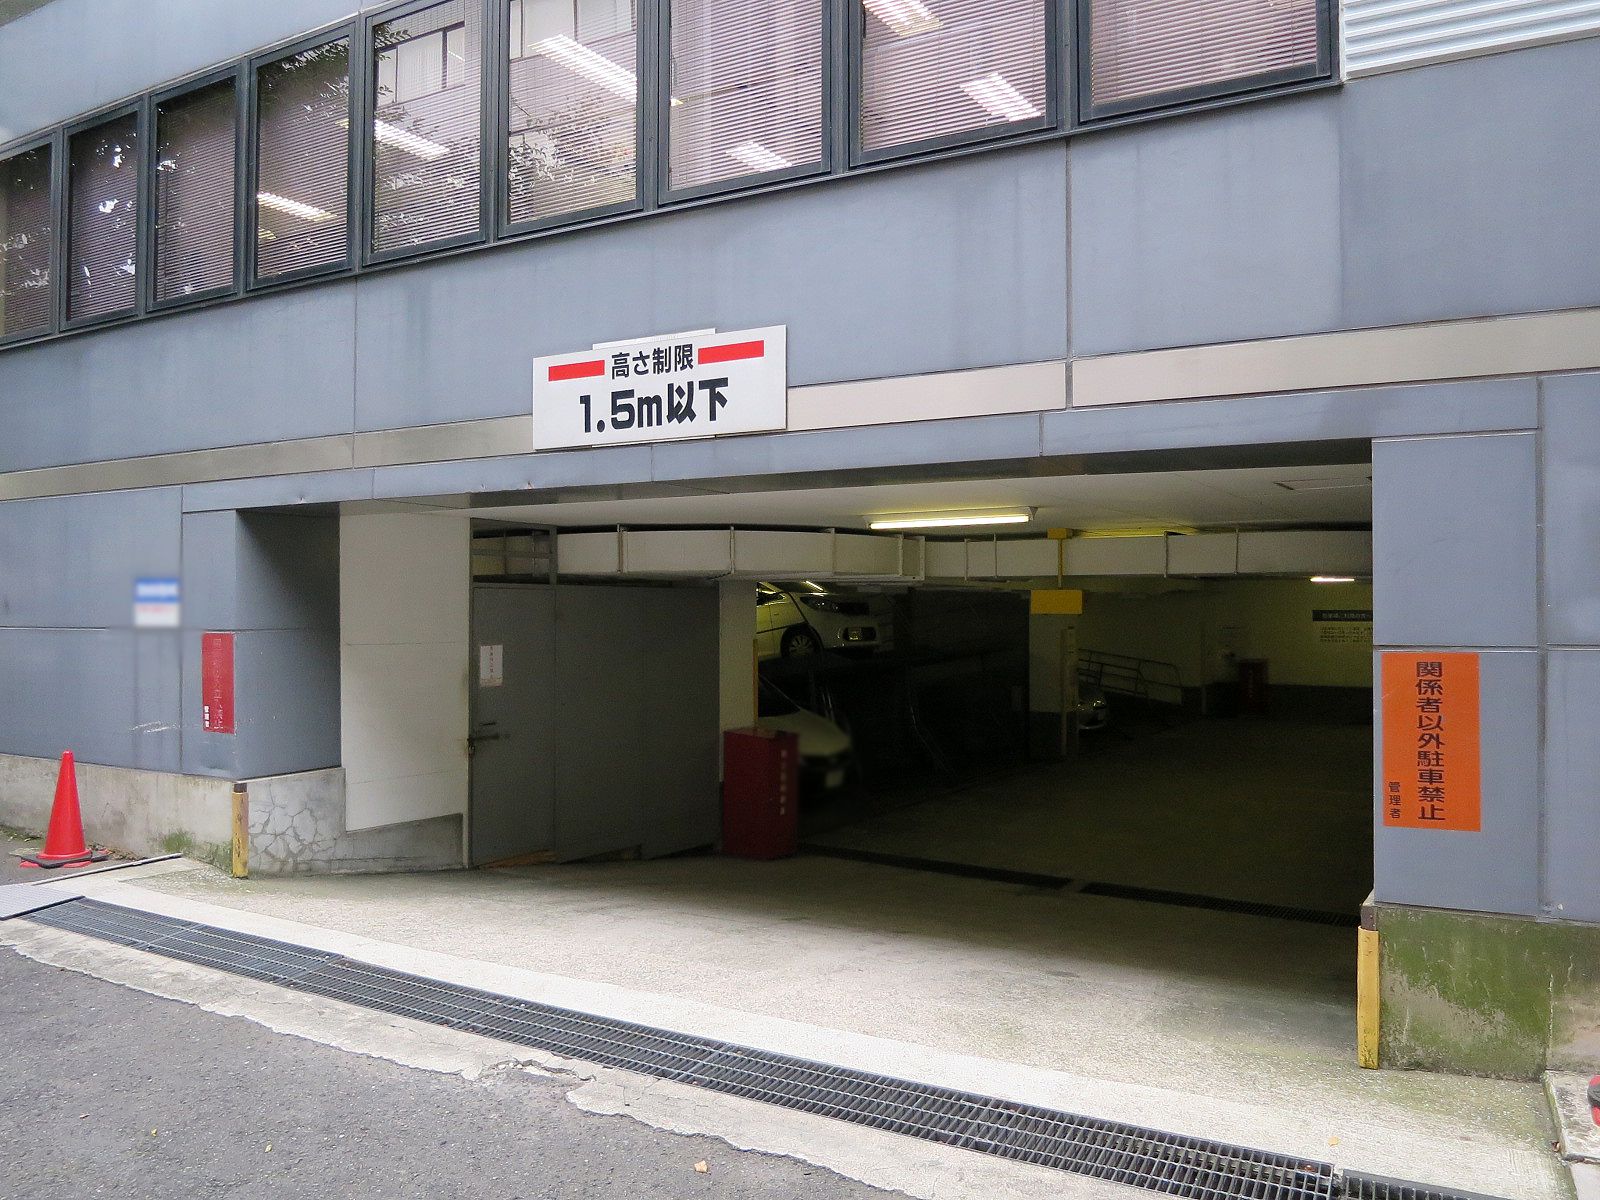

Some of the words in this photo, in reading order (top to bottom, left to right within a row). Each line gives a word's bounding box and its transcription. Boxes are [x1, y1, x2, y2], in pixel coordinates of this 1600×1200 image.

[611, 344, 694, 380] 高さ制限
[580, 377, 729, 433] 1.5m以下
[1415, 661, 1446, 821] 関係者以外駐車禁止
[1388, 781, 1402, 819] 管理者
